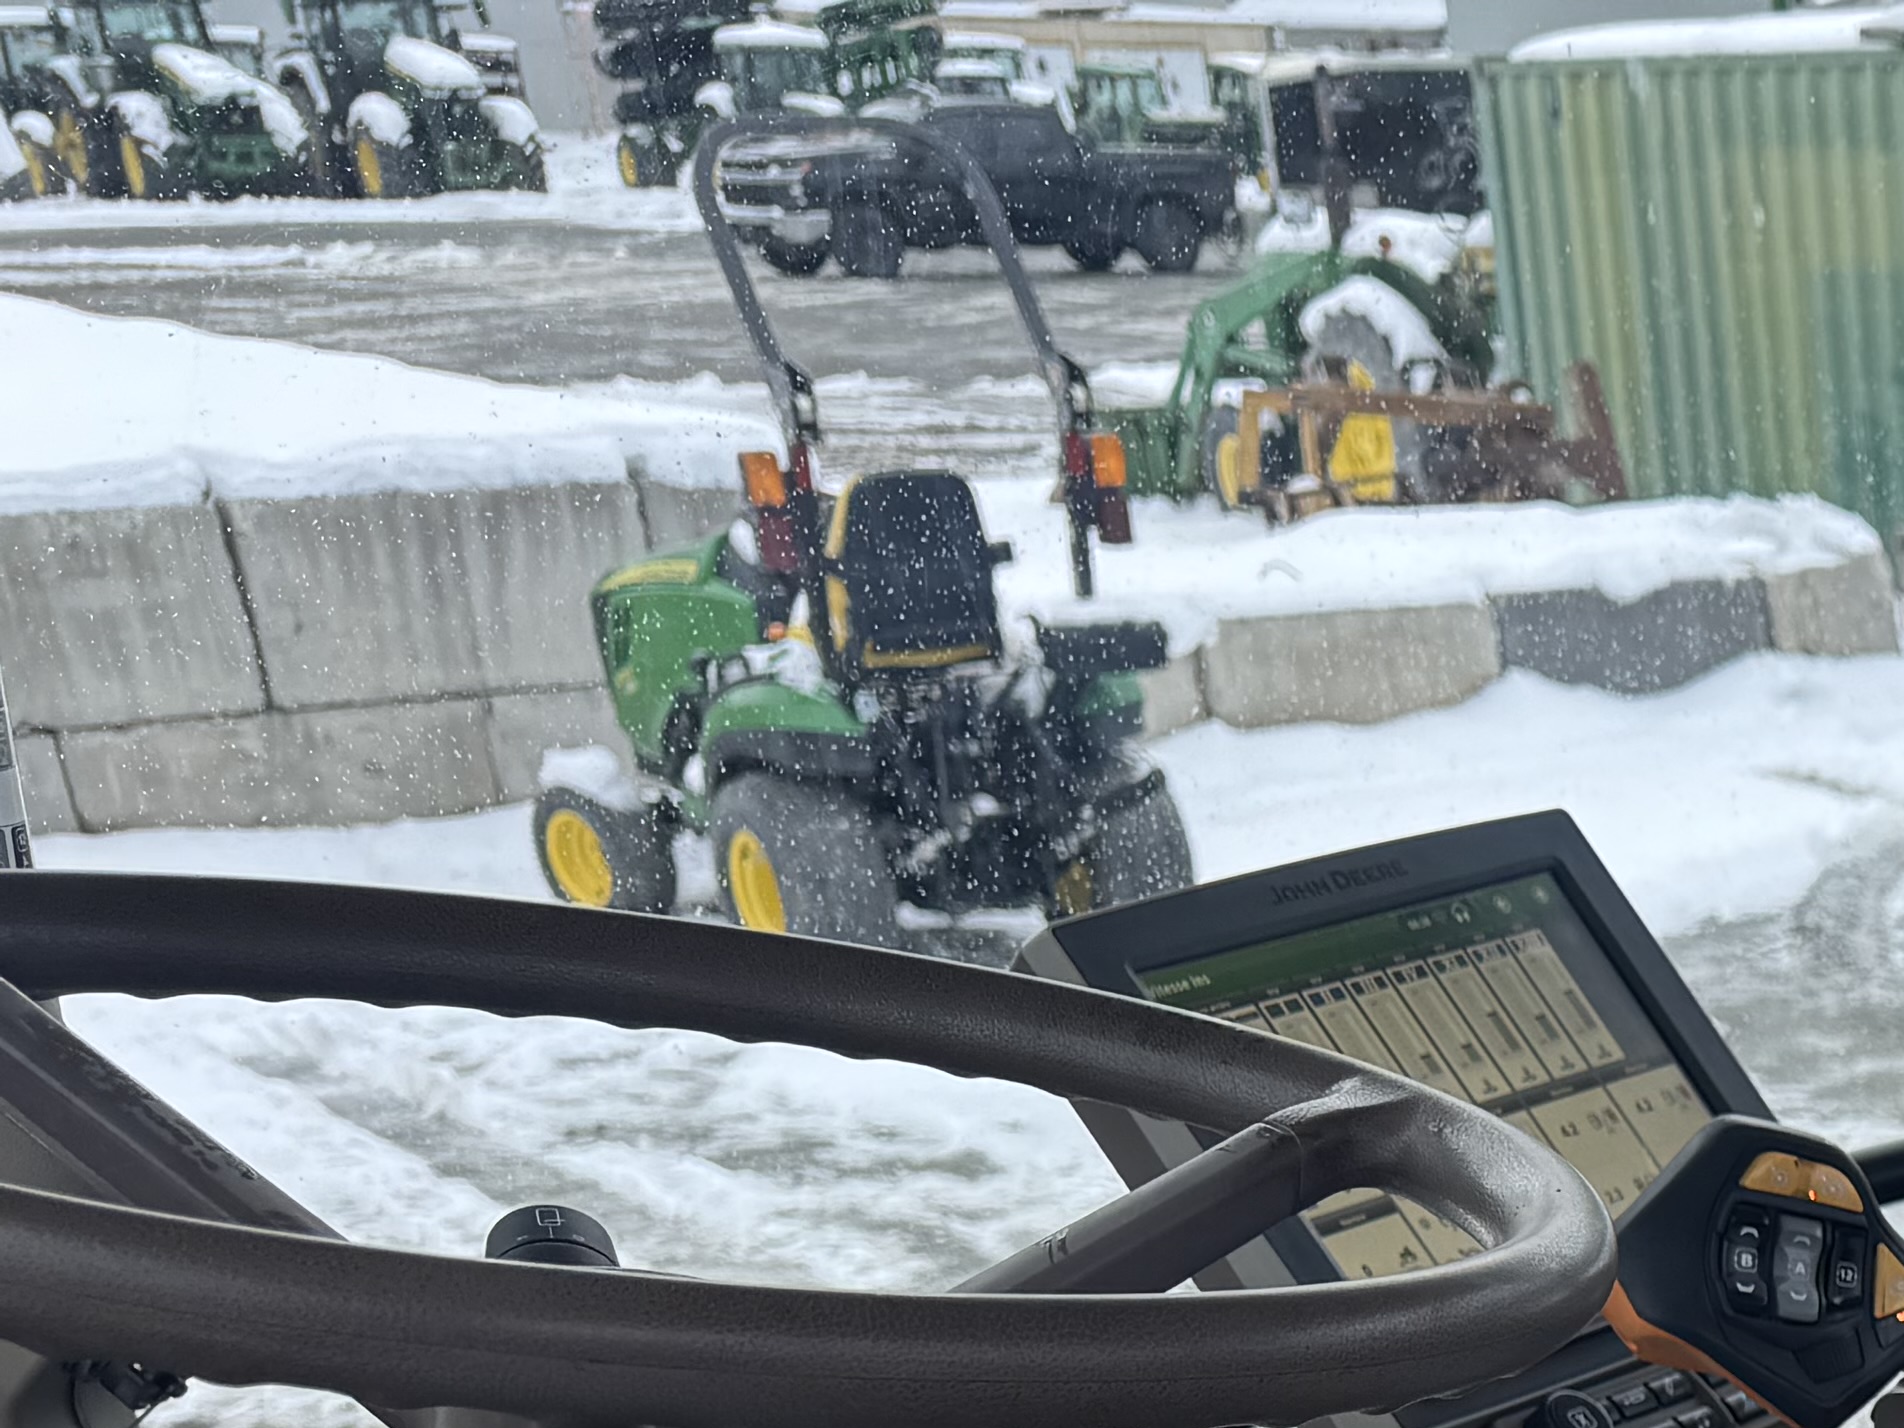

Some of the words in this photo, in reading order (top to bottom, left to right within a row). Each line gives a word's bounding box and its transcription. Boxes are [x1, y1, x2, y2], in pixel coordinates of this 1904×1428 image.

[1269, 876, 1333, 905] JOHN
[1328, 859, 1408, 891] DEERE
[1741, 1253, 1753, 1267] B
[1795, 1262, 1806, 1276] A
